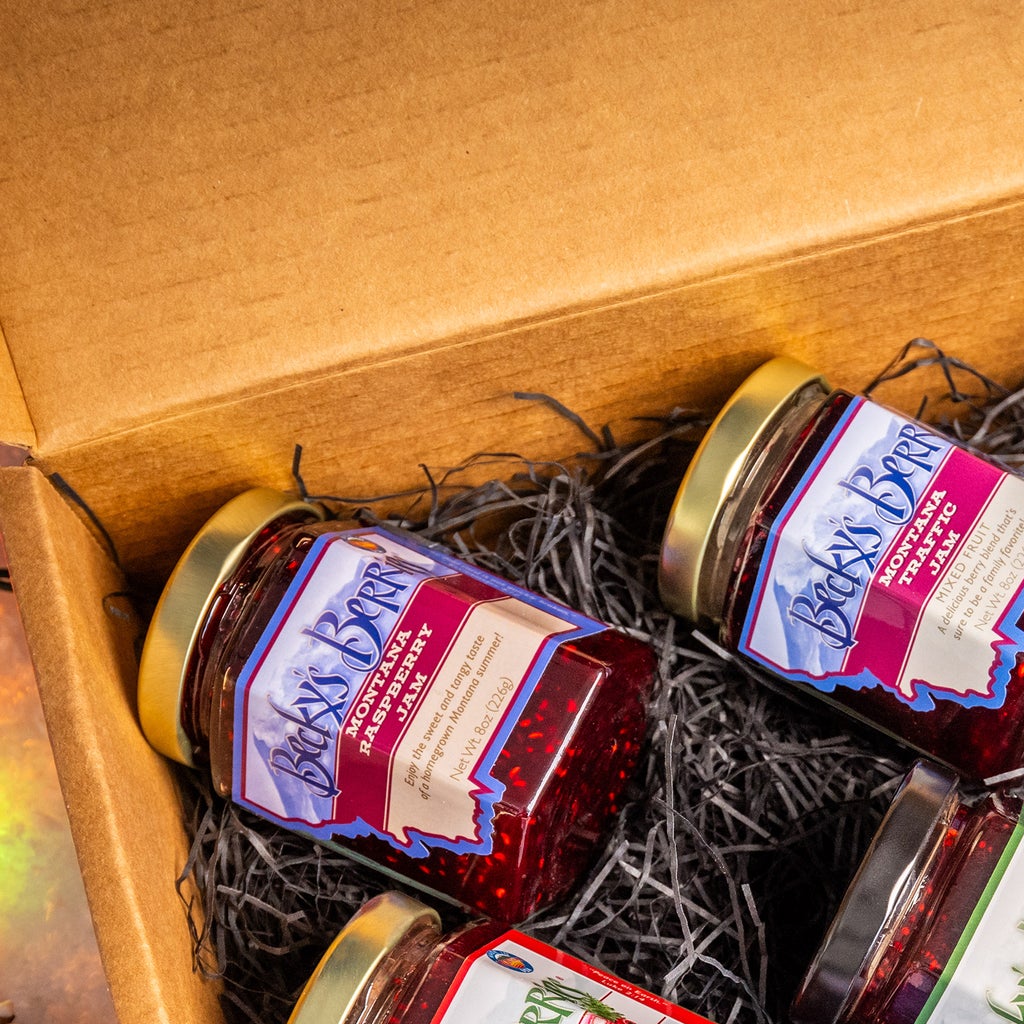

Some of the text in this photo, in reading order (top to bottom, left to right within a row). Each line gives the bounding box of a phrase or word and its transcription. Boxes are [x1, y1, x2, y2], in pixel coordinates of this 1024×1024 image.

[787, 514, 882, 649] Becky's
[878, 488, 947, 587] MONTANA
[897, 501, 958, 586] TRAFFIC
[926, 529, 961, 576] JAM
[935, 521, 991, 604] MIXED FRUIT
[937, 506, 1017, 635] A delicious berry blend that's
[952, 617, 967, 640] sure
[963, 606, 975, 619] to
[969, 591, 982, 607] be
[982, 555, 1006, 586] family
[267, 662, 349, 800] Becky's
[342, 627, 413, 739] MONTANA
[357, 622, 435, 756] RASPBERRY
[392, 670, 428, 722] JAM
[403, 633, 486, 786] Enjoy the sweet and tangy taste
[419, 631, 504, 783] homegrown Montana summer!
